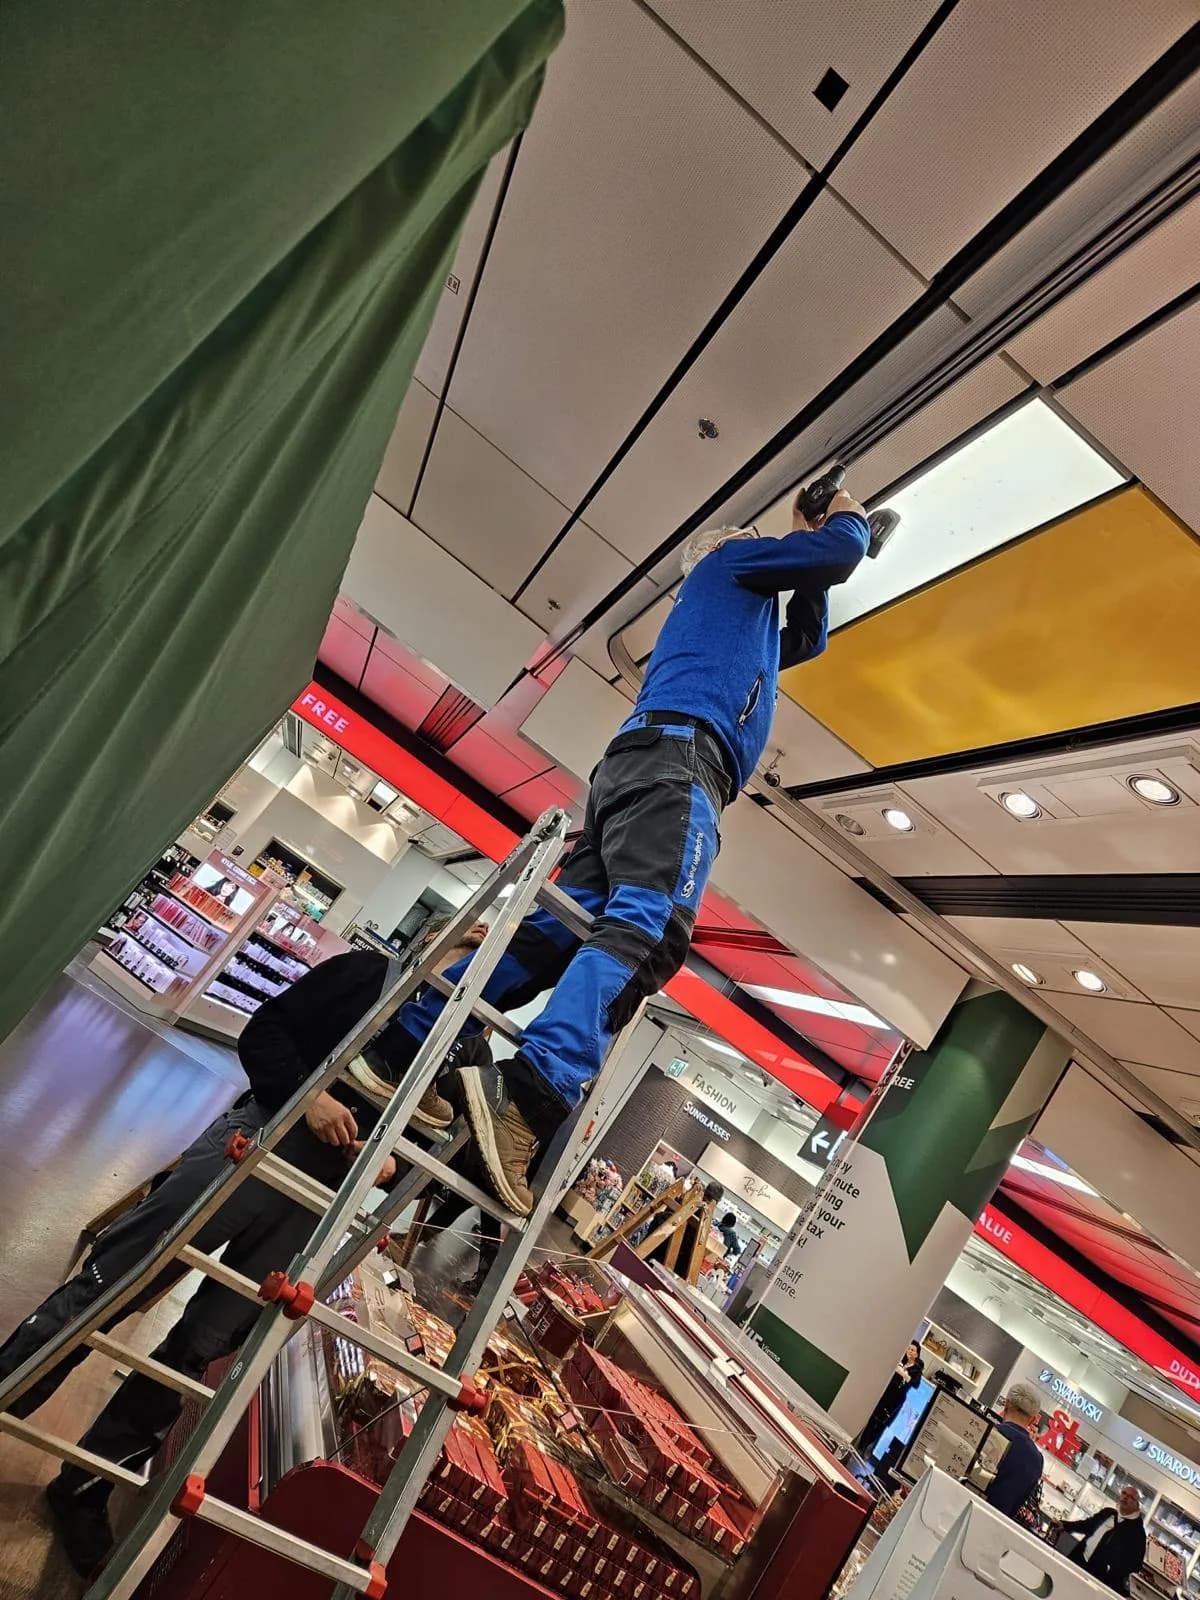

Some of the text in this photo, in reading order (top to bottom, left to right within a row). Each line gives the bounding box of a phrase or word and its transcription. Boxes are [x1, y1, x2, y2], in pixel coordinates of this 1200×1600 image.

[300, 692, 350, 734] FREE
[691, 1073, 737, 1114] FASHION
[683, 1101, 731, 1141] SUNGLASSES
[805, 1219, 825, 1239] tax
[817, 1207, 846, 1230] your
[774, 1277, 796, 1299] more.
[782, 1265, 804, 1285] staff
[1051, 1378, 1103, 1423] SWAROVSKI
